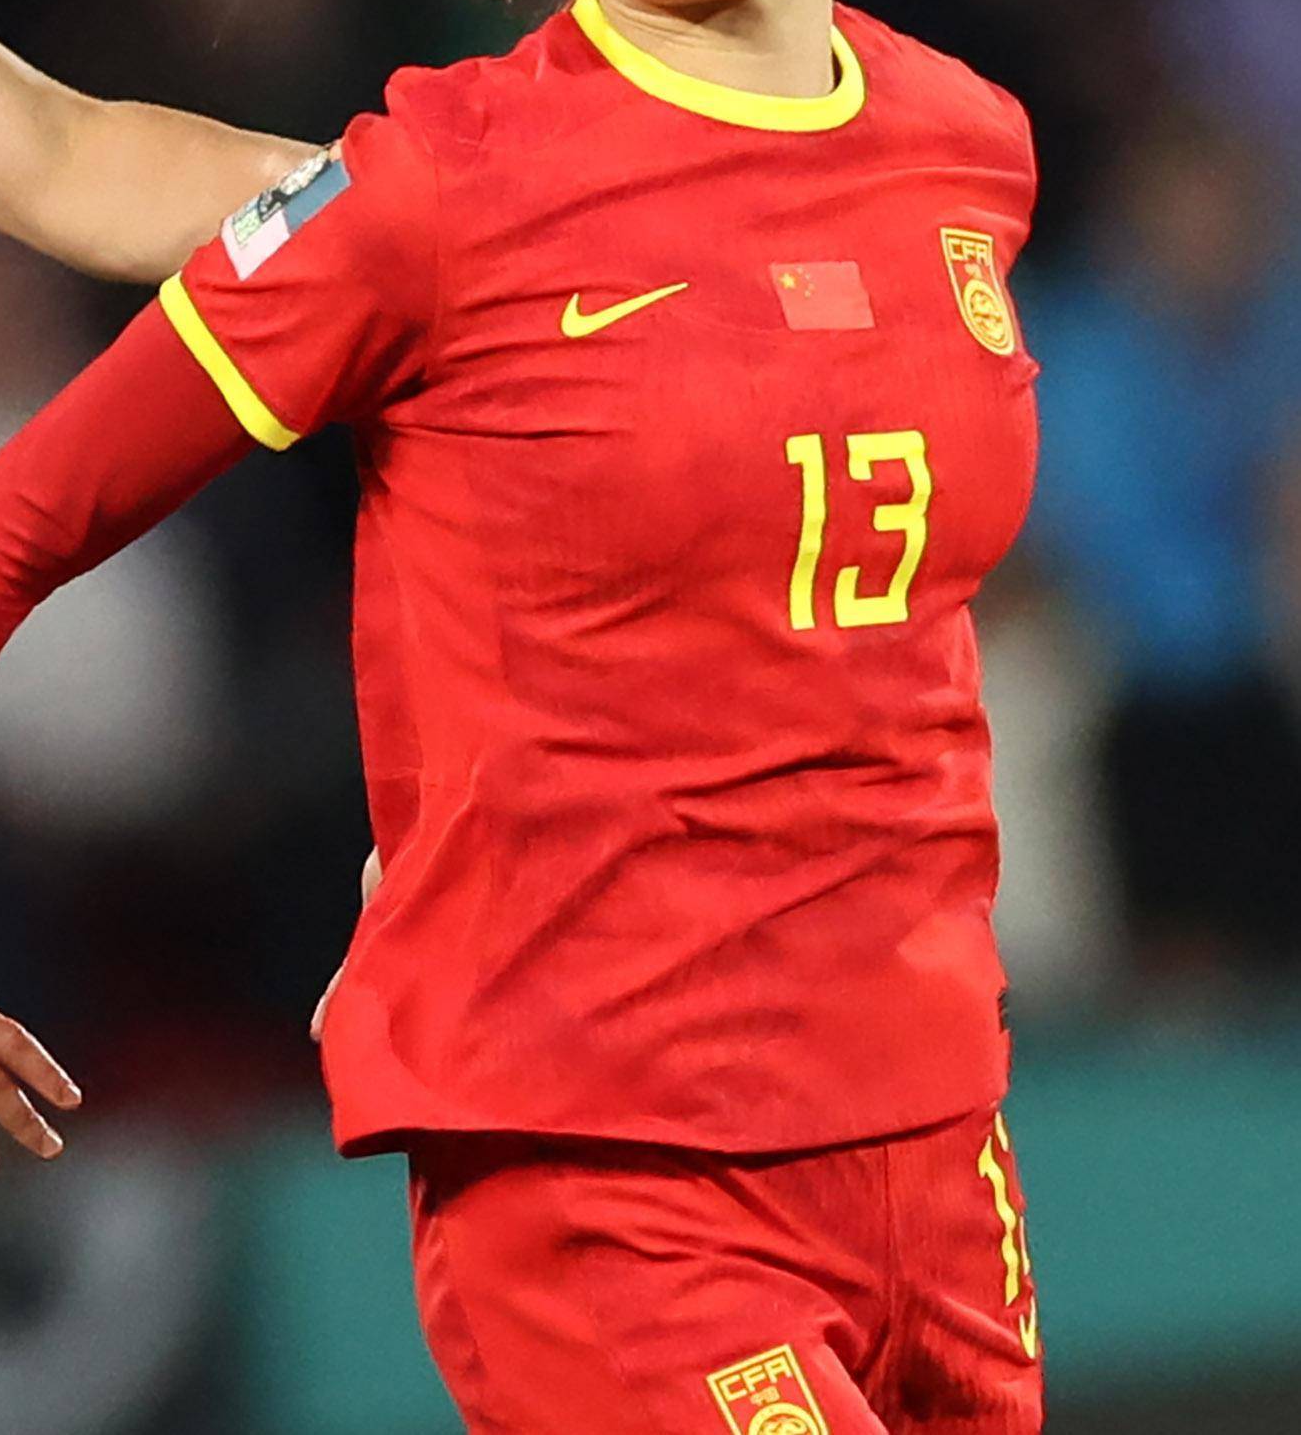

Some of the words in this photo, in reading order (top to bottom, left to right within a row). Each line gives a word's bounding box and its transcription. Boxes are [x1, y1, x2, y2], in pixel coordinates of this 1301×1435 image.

[947, 237, 990, 267] CFA
[785, 429, 932, 631] 13
[718, 1355, 793, 1402] CFA
